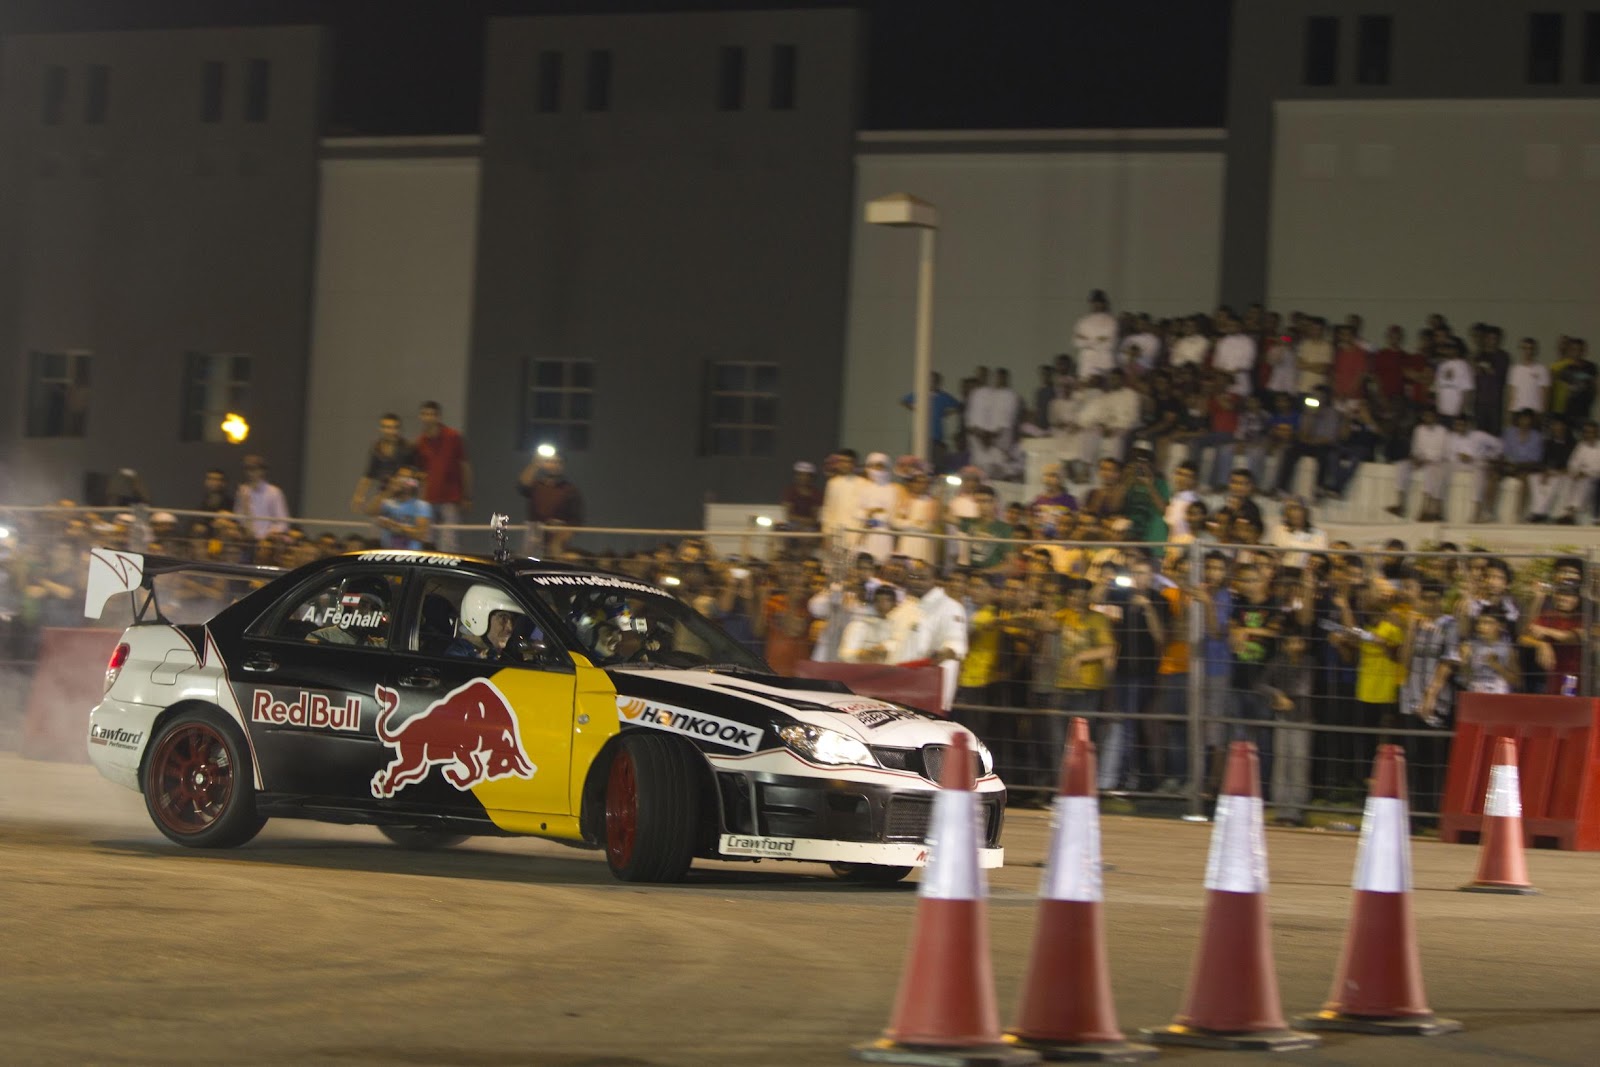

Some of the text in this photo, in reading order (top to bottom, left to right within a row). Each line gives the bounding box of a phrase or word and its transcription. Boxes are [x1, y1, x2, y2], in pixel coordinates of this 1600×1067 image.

[302, 606, 383, 630] A. Feghali
[91, 724, 144, 745] Crawford
[727, 836, 796, 851] Crawford
